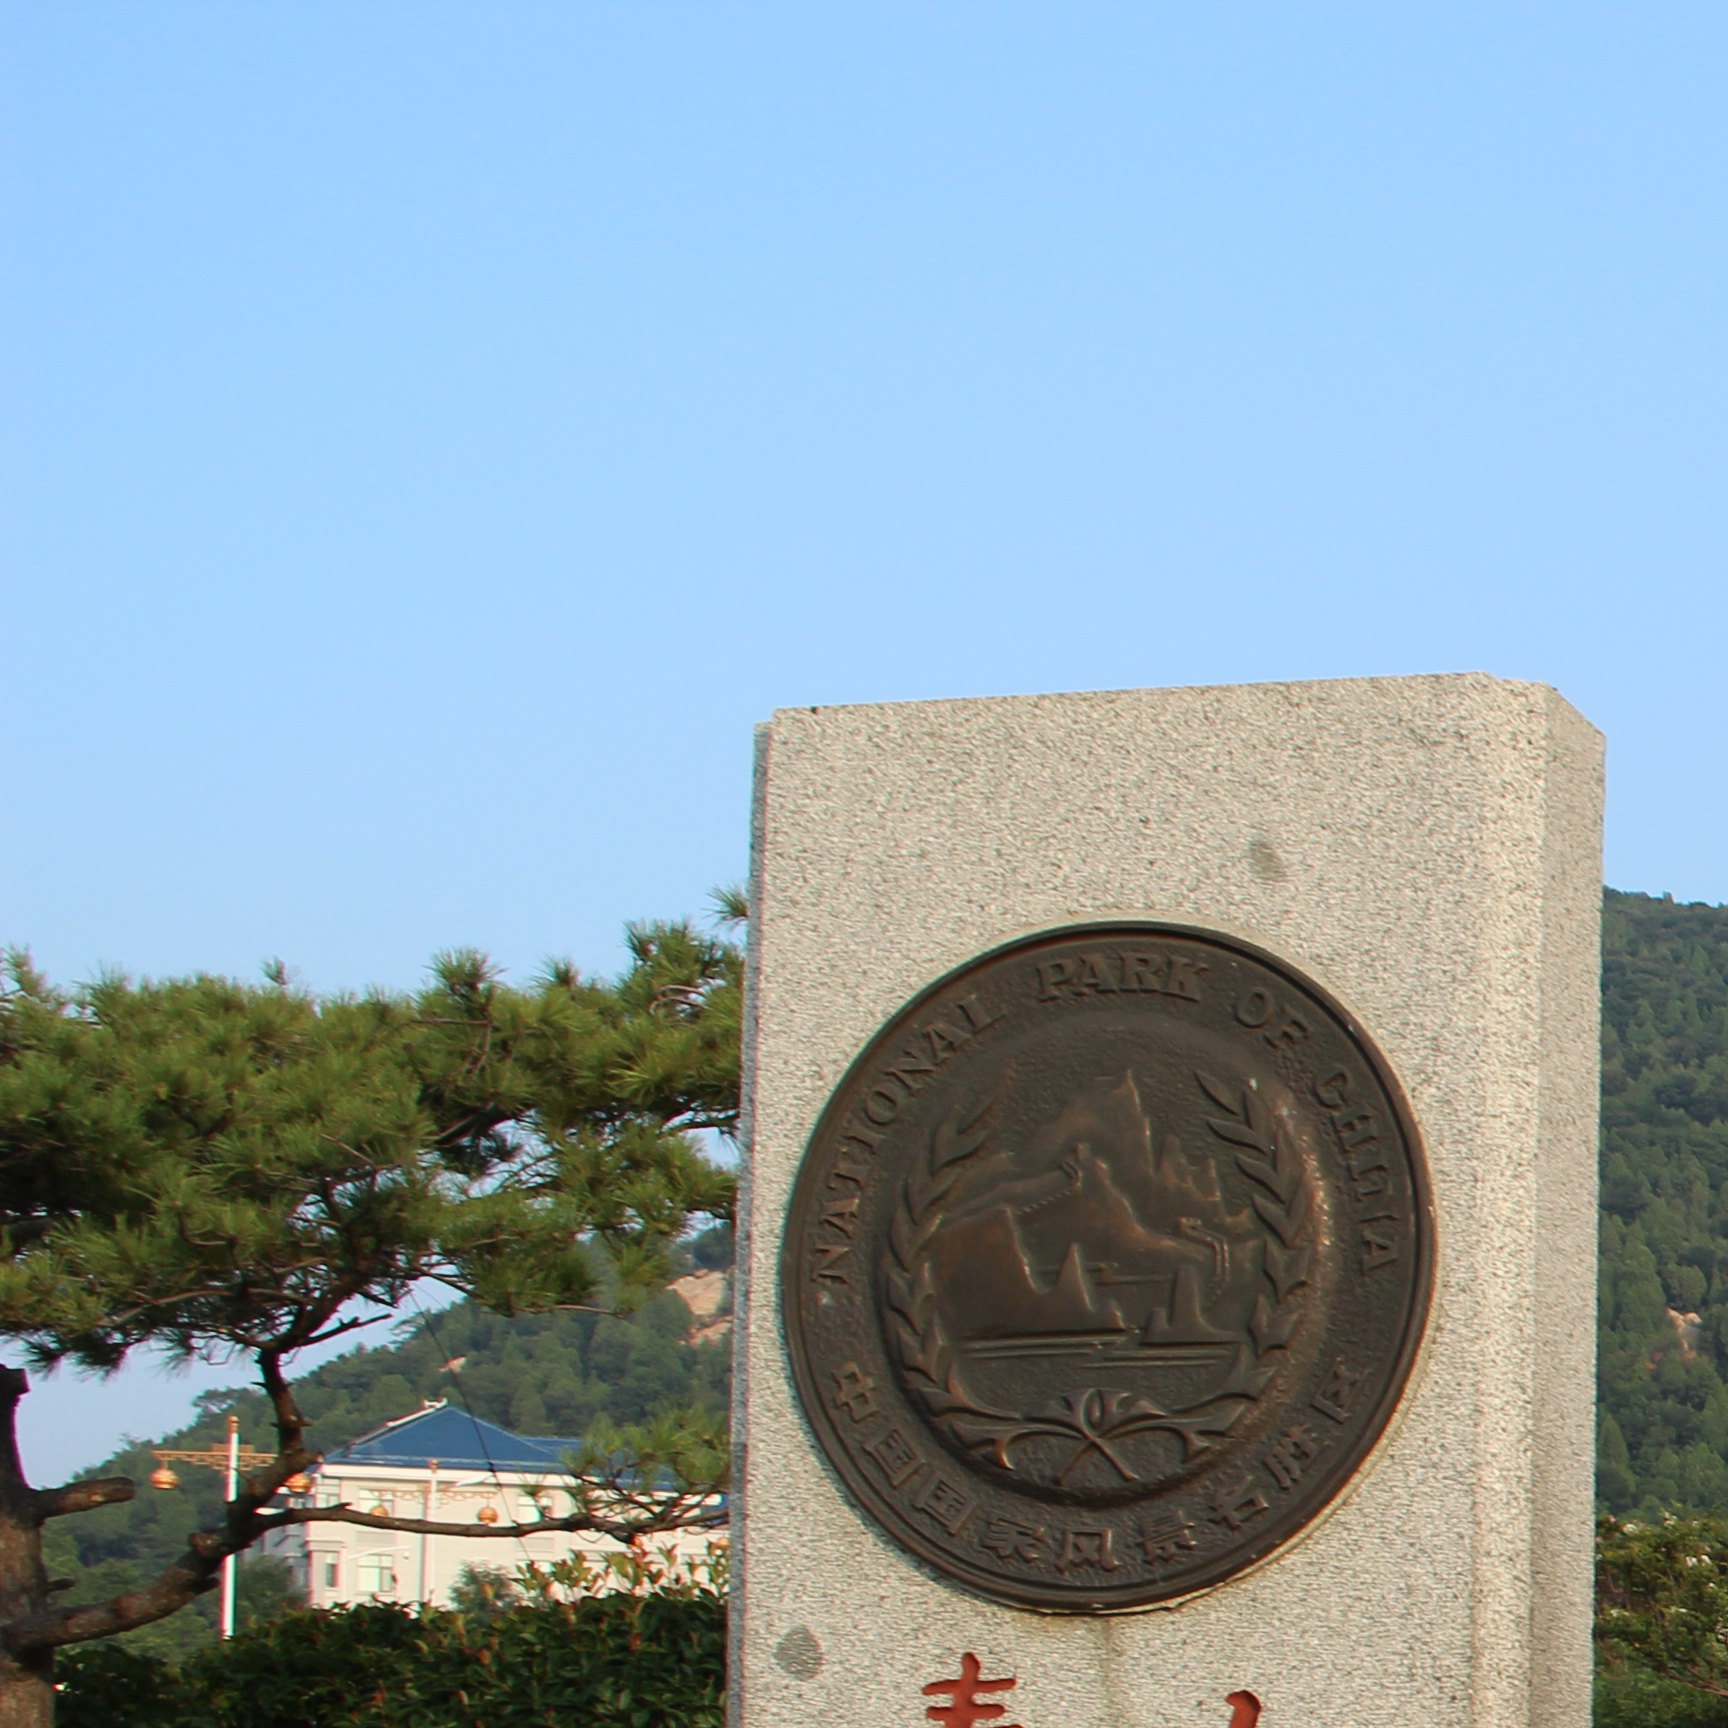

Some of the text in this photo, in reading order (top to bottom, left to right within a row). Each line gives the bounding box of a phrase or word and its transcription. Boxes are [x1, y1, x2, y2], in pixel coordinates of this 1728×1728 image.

[811, 951, 1400, 1286] NATIONAL PARK OF CHINA
[831, 1357, 1374, 1574] 中国国家风景名胜区
